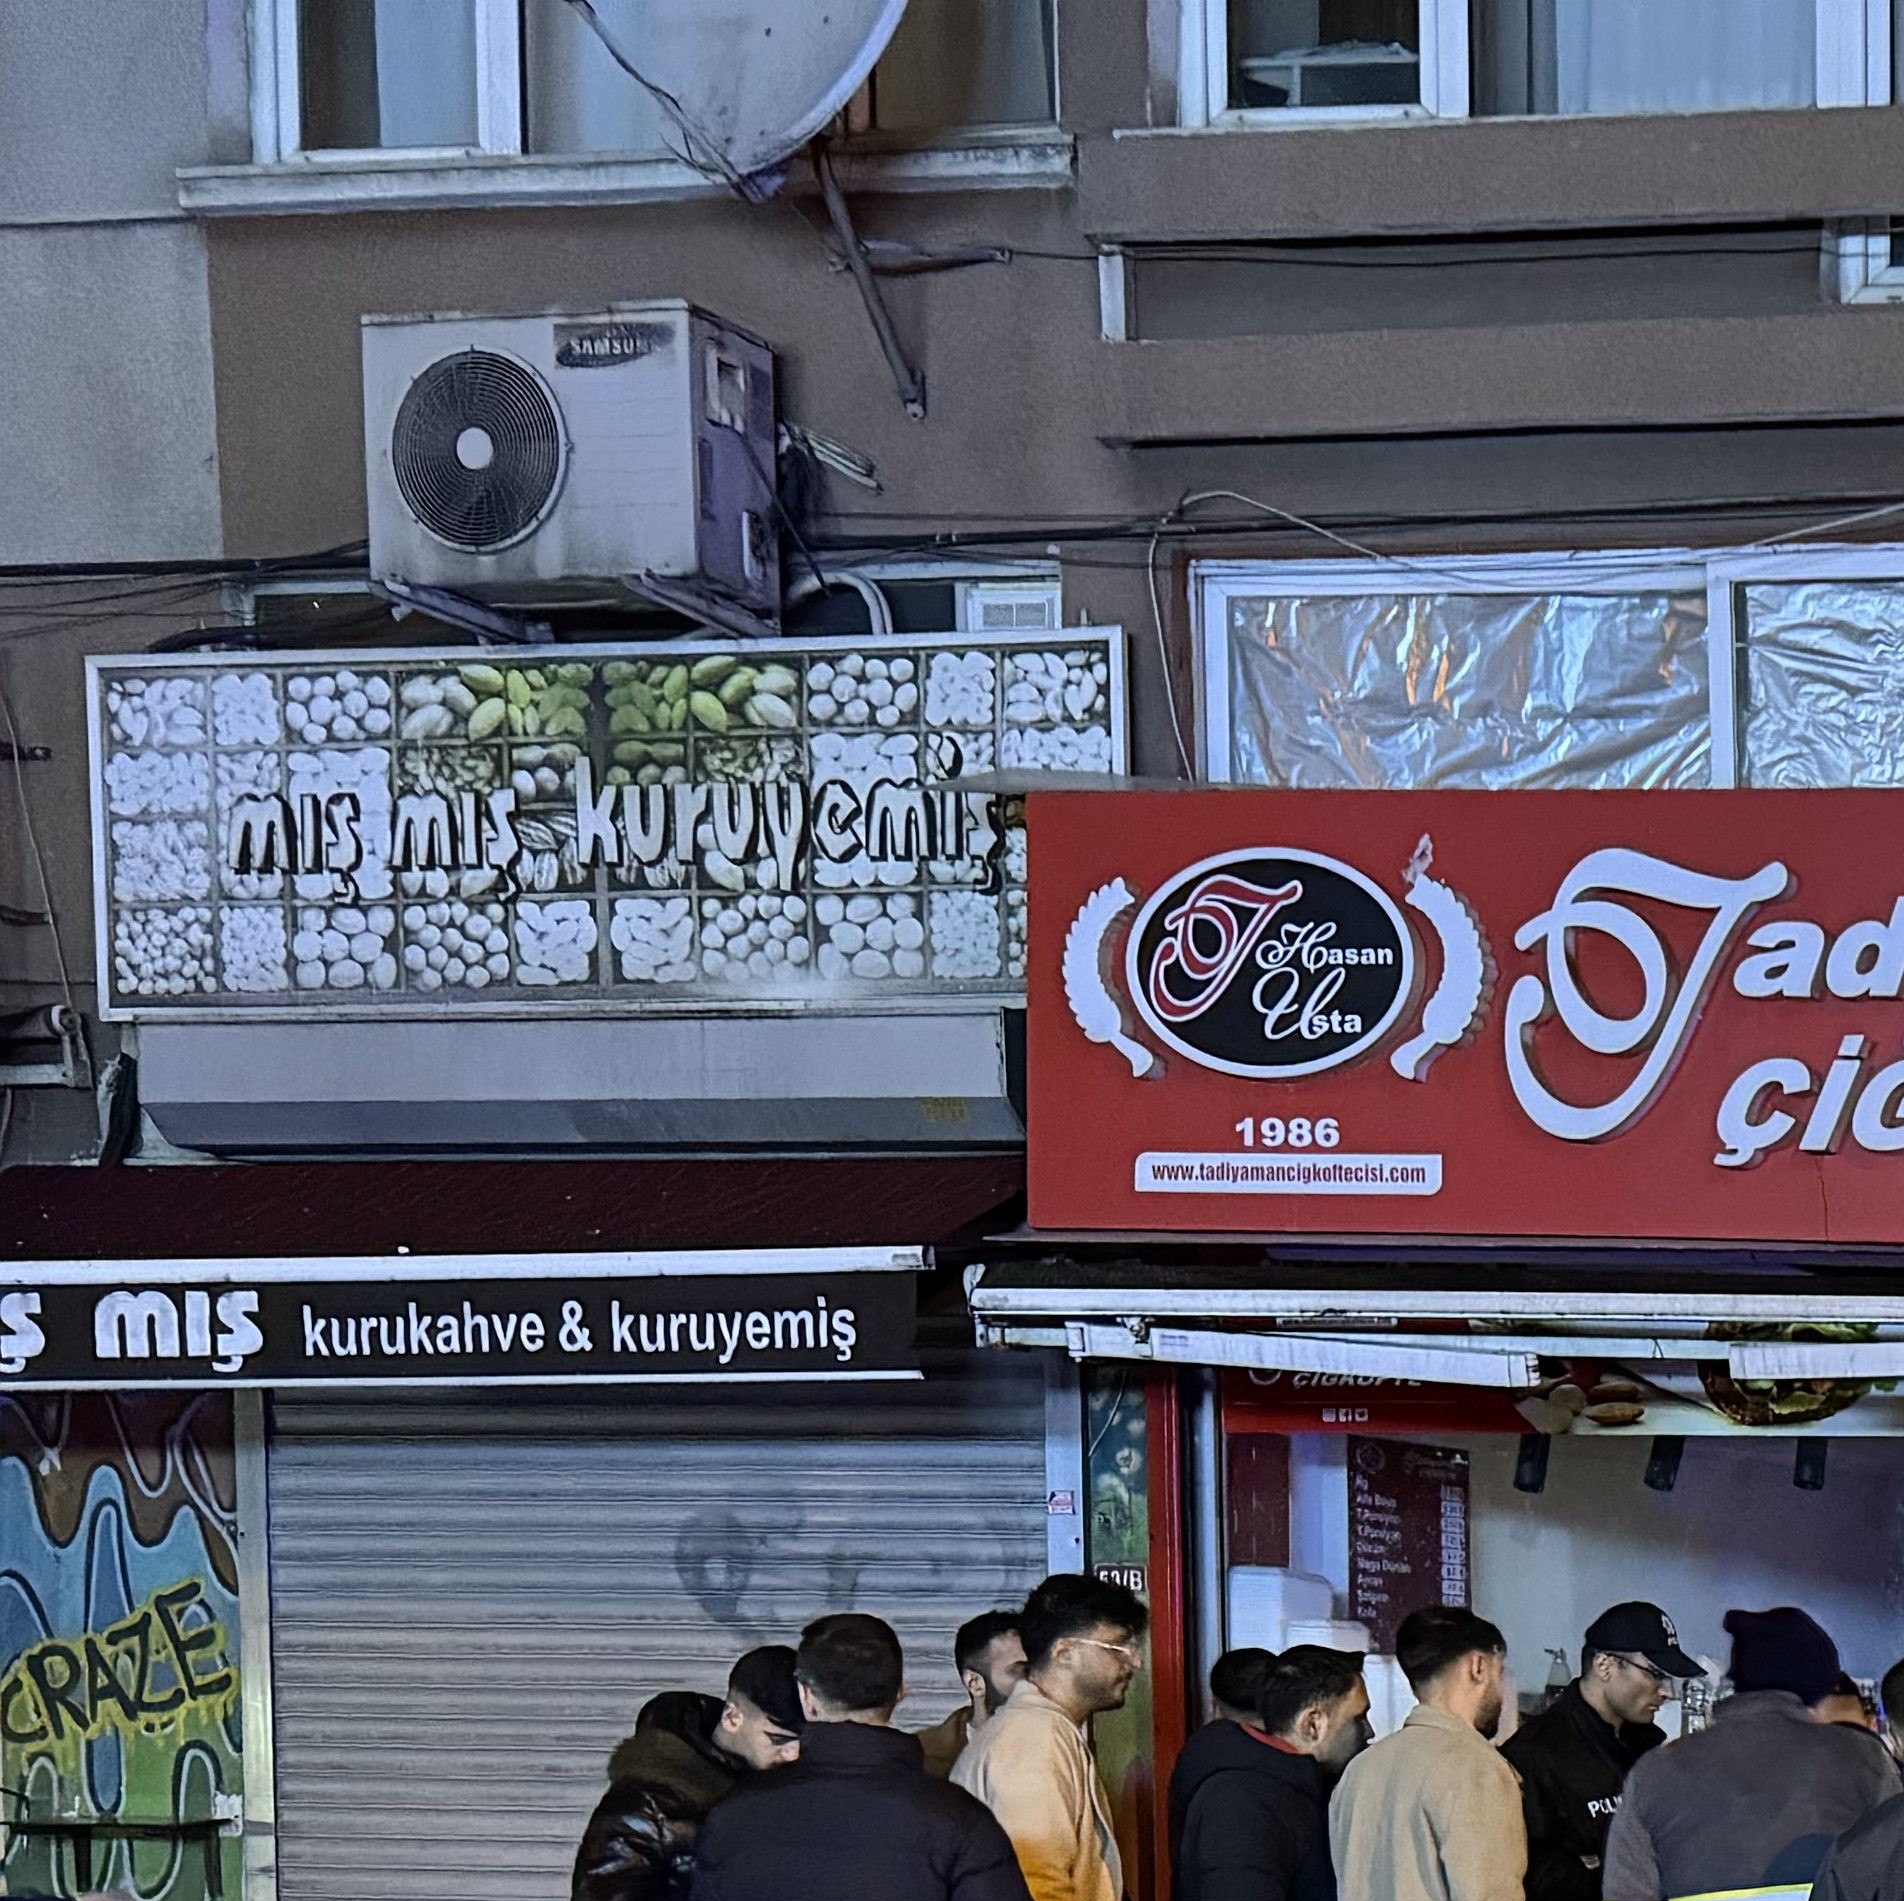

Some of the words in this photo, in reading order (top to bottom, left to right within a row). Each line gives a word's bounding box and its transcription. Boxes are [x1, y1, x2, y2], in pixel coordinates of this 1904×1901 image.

[1255, 922, 1393, 973] Hasan
[1252, 969, 1363, 1040] Usta
[1235, 1117, 1341, 1147] 1986
[302, 1303, 544, 1359] kurukahve
[558, 1299, 591, 1355] &
[611, 1296, 856, 1366] kuruyemiş
[0, 1582, 232, 1745] CRAZE
